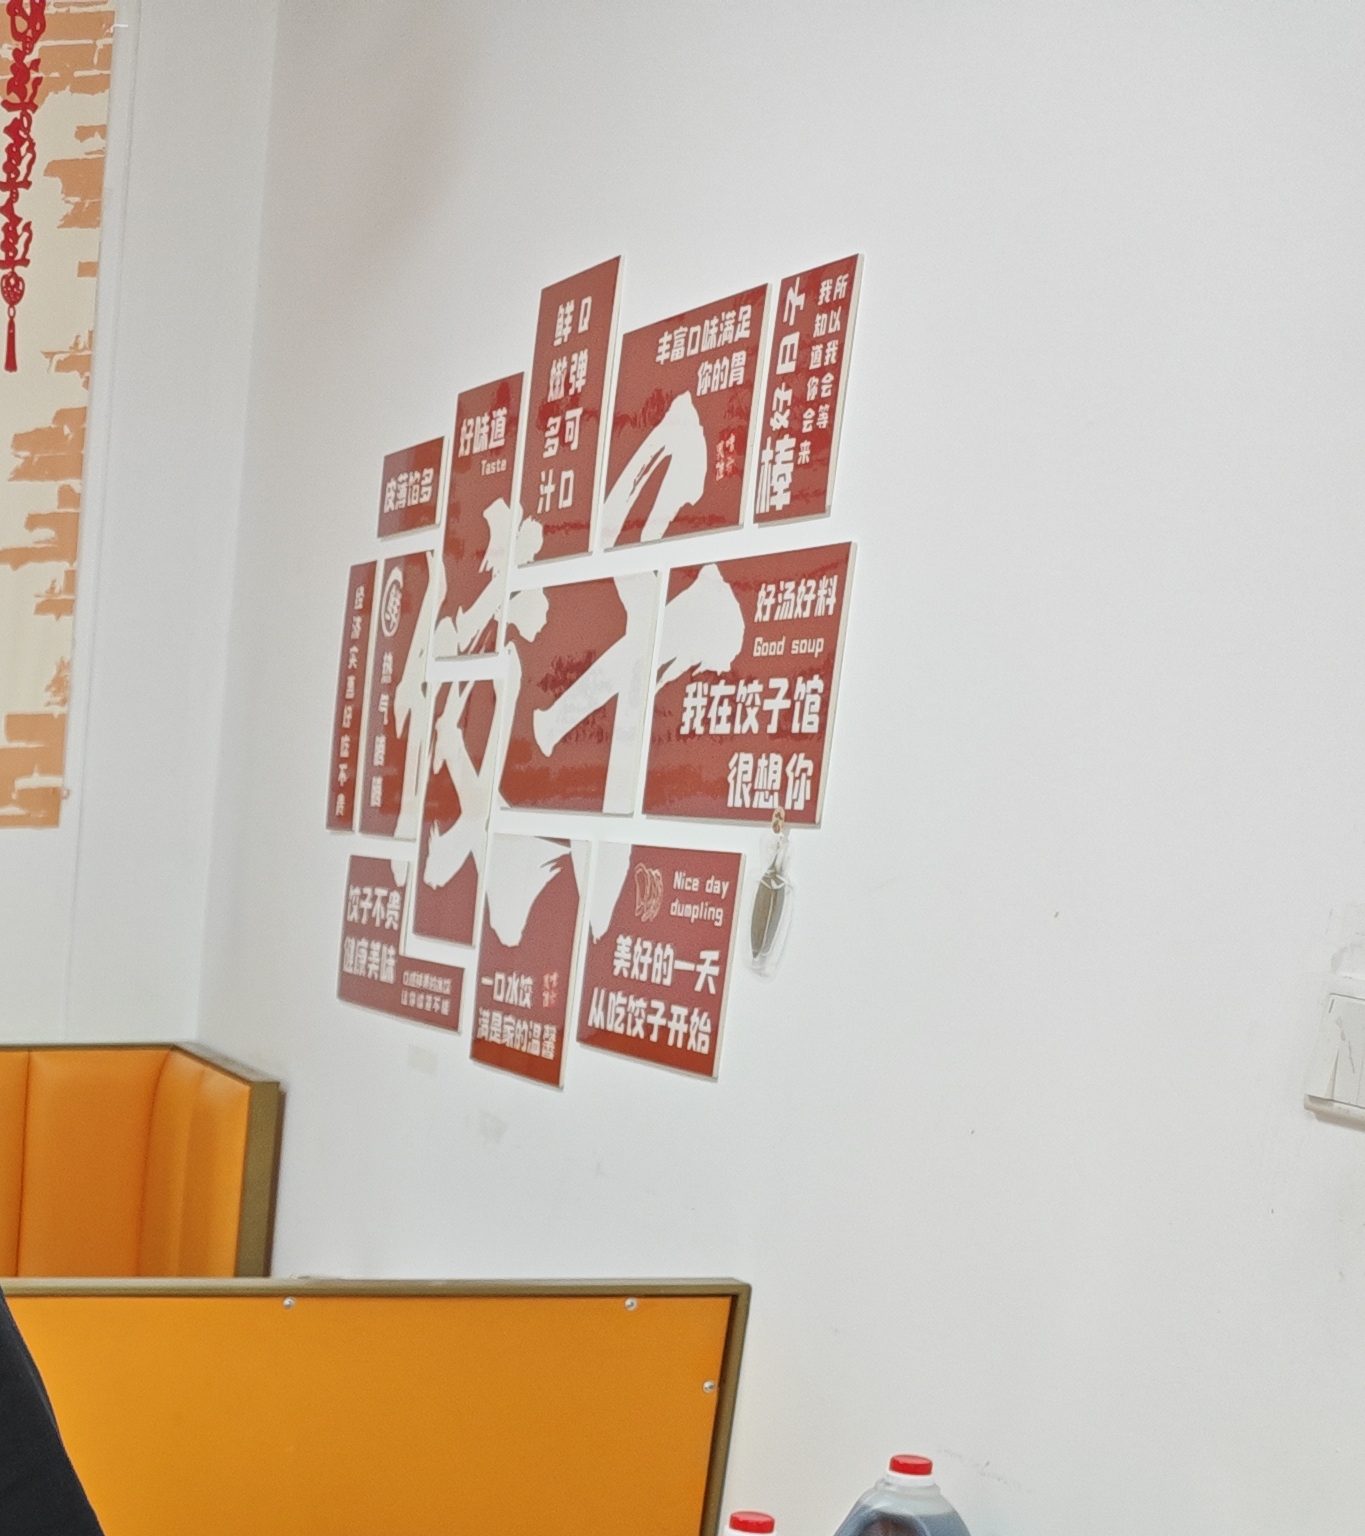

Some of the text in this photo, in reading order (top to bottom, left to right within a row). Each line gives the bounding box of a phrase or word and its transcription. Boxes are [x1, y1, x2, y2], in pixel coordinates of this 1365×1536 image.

[655, 304, 752, 366] 丰富口味满足
[816, 273, 849, 429] 所以我会等
[696, 350, 747, 397] 你的胃
[797, 279, 833, 465] 我知道你会来
[536, 300, 574, 514] 鲜嫩多汁
[458, 407, 507, 458] 好味道
[383, 467, 434, 513] 皮薄馅多
[481, 459, 507, 476] Taste
[754, 575, 838, 622] 好汤好料
[753, 636, 824, 658] Good soup
[680, 674, 824, 735] 我在饺子馆
[726, 752, 814, 810] 很想你
[346, 884, 401, 930] 饺子不贵
[673, 871, 730, 899] Nice day
[670, 898, 724, 927] dumpling
[342, 935, 396, 984] 健康美味
[613, 934, 720, 994] 美好的一天
[481, 971, 533, 1009] 一口水饺
[477, 1007, 557, 1060] 满是家的温馨
[588, 987, 712, 1055] 从吃饺子开始
